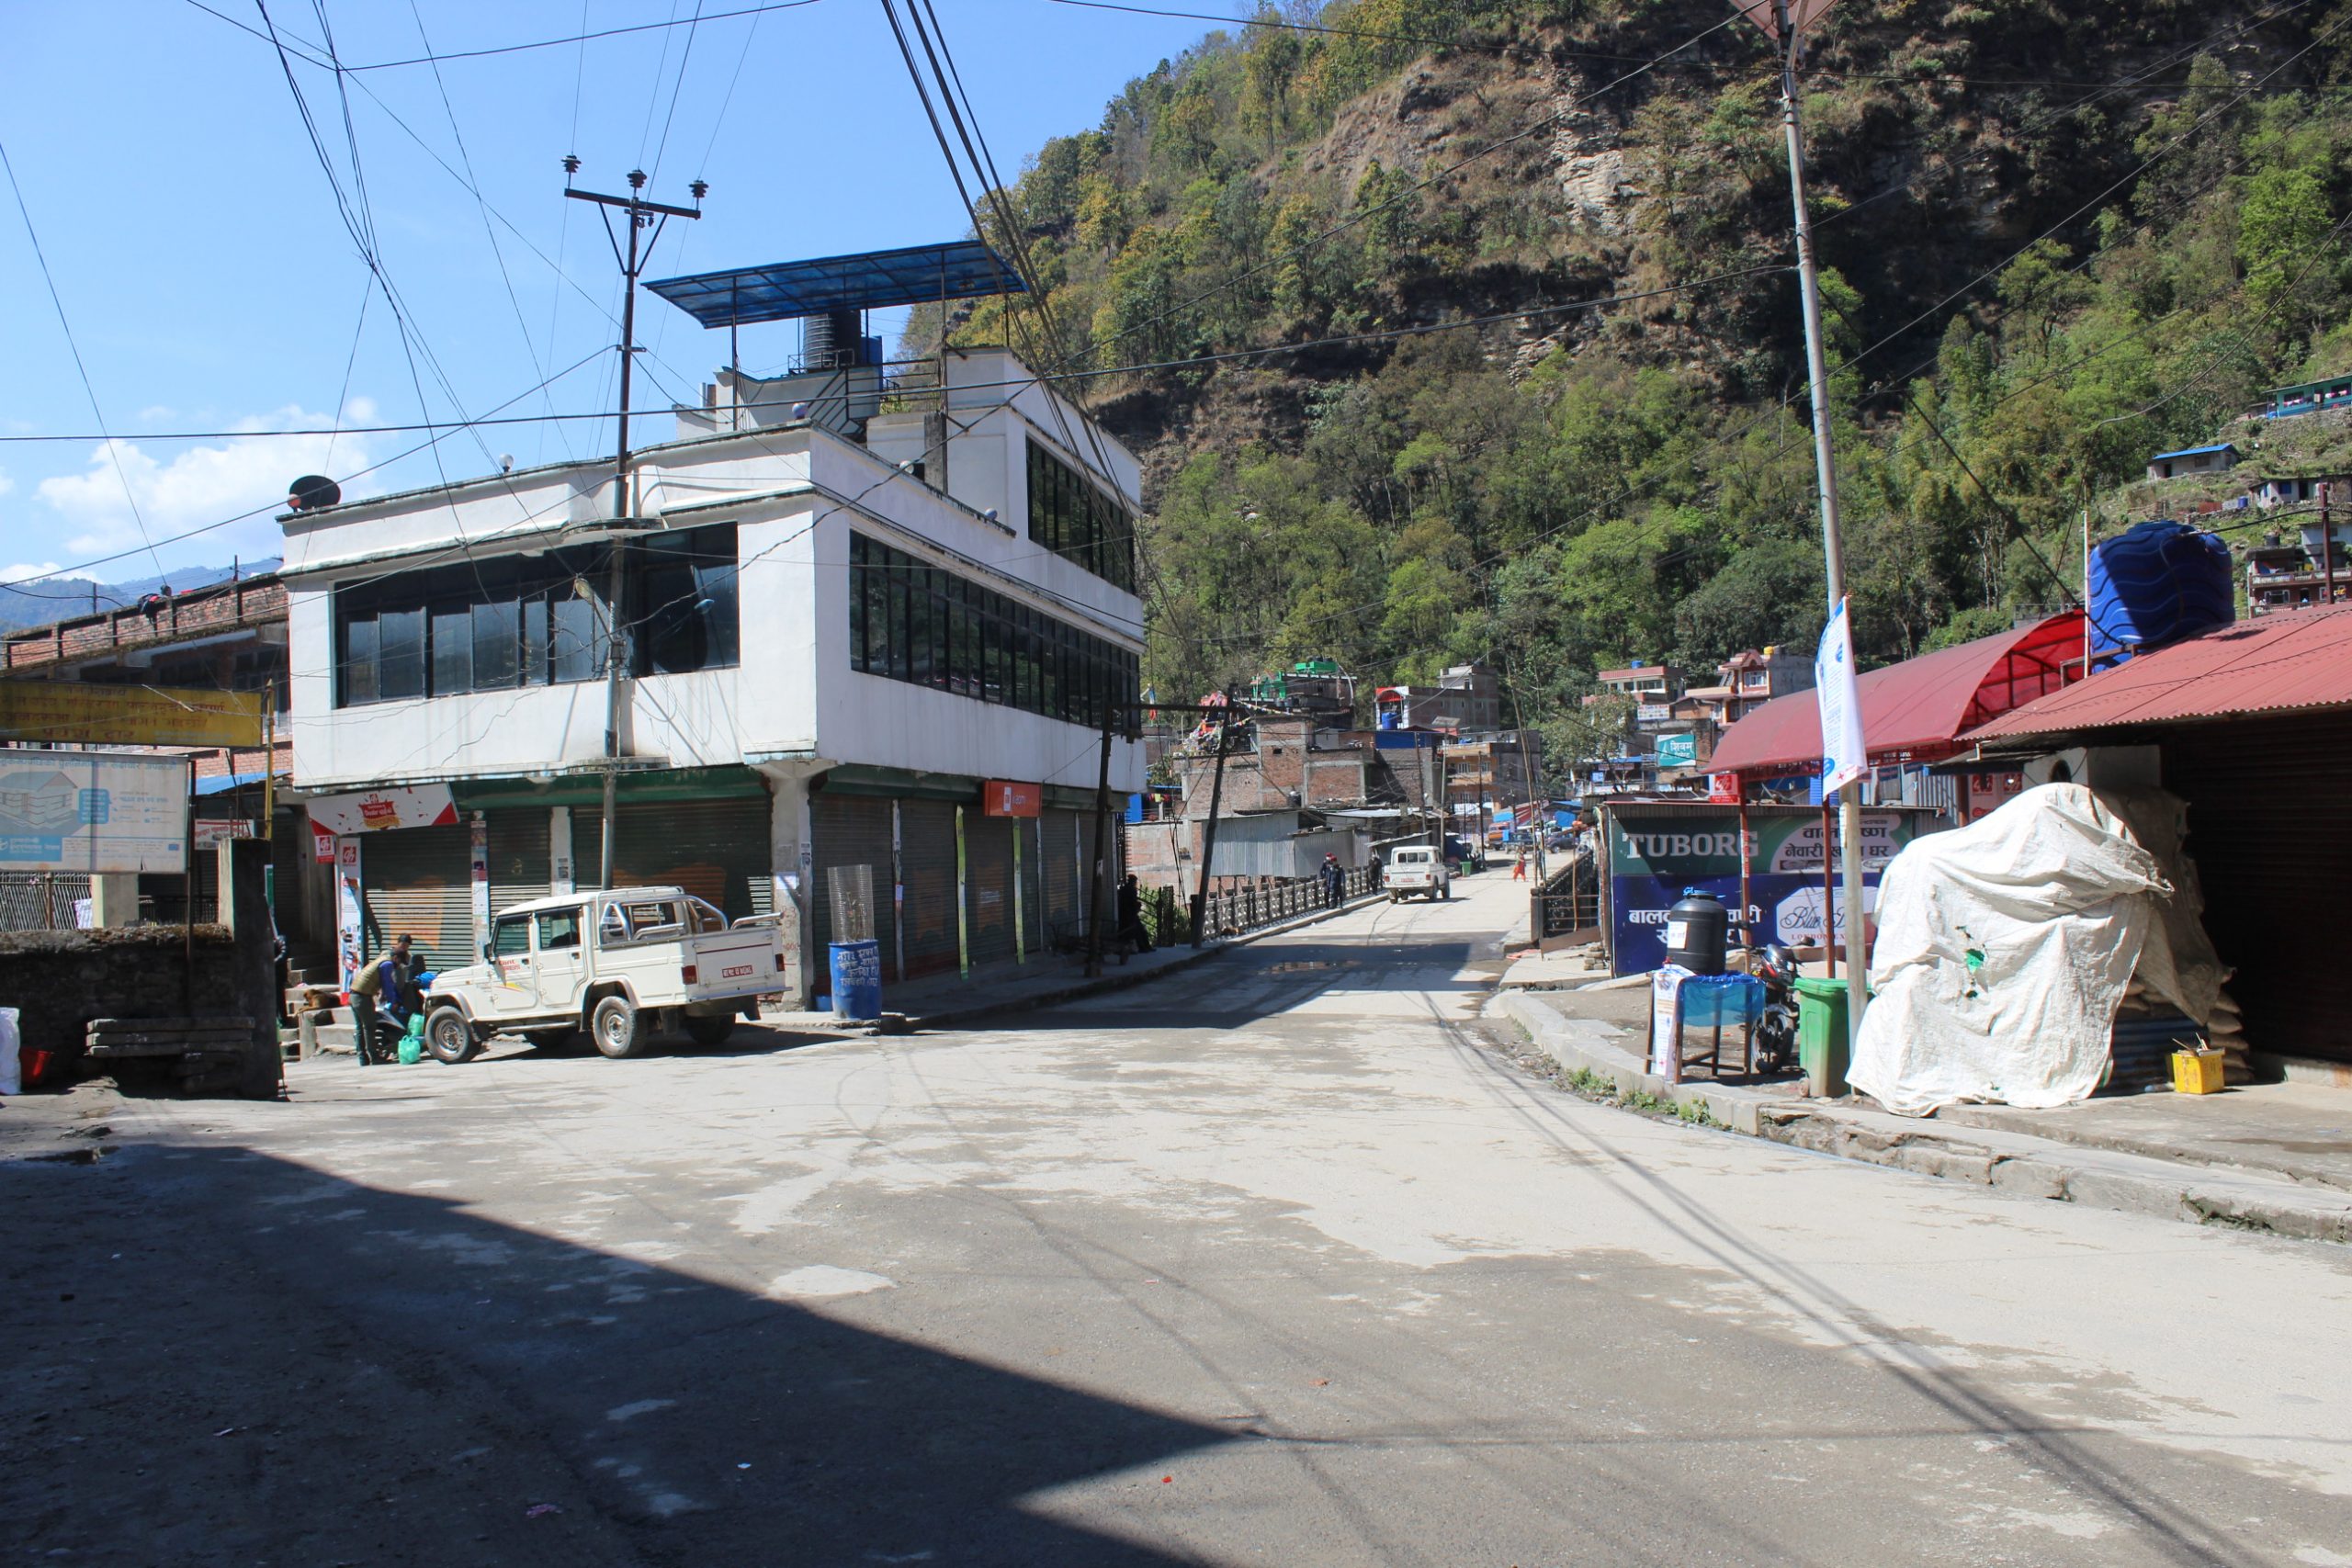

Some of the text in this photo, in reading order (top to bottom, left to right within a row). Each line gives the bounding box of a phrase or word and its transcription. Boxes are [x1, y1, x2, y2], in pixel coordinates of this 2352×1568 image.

[1622, 830, 1759, 859] TUBORG
[1785, 842, 1824, 858] नेवारी
[1869, 845, 1890, 857] घर
[1780, 906, 1821, 930] Blue
